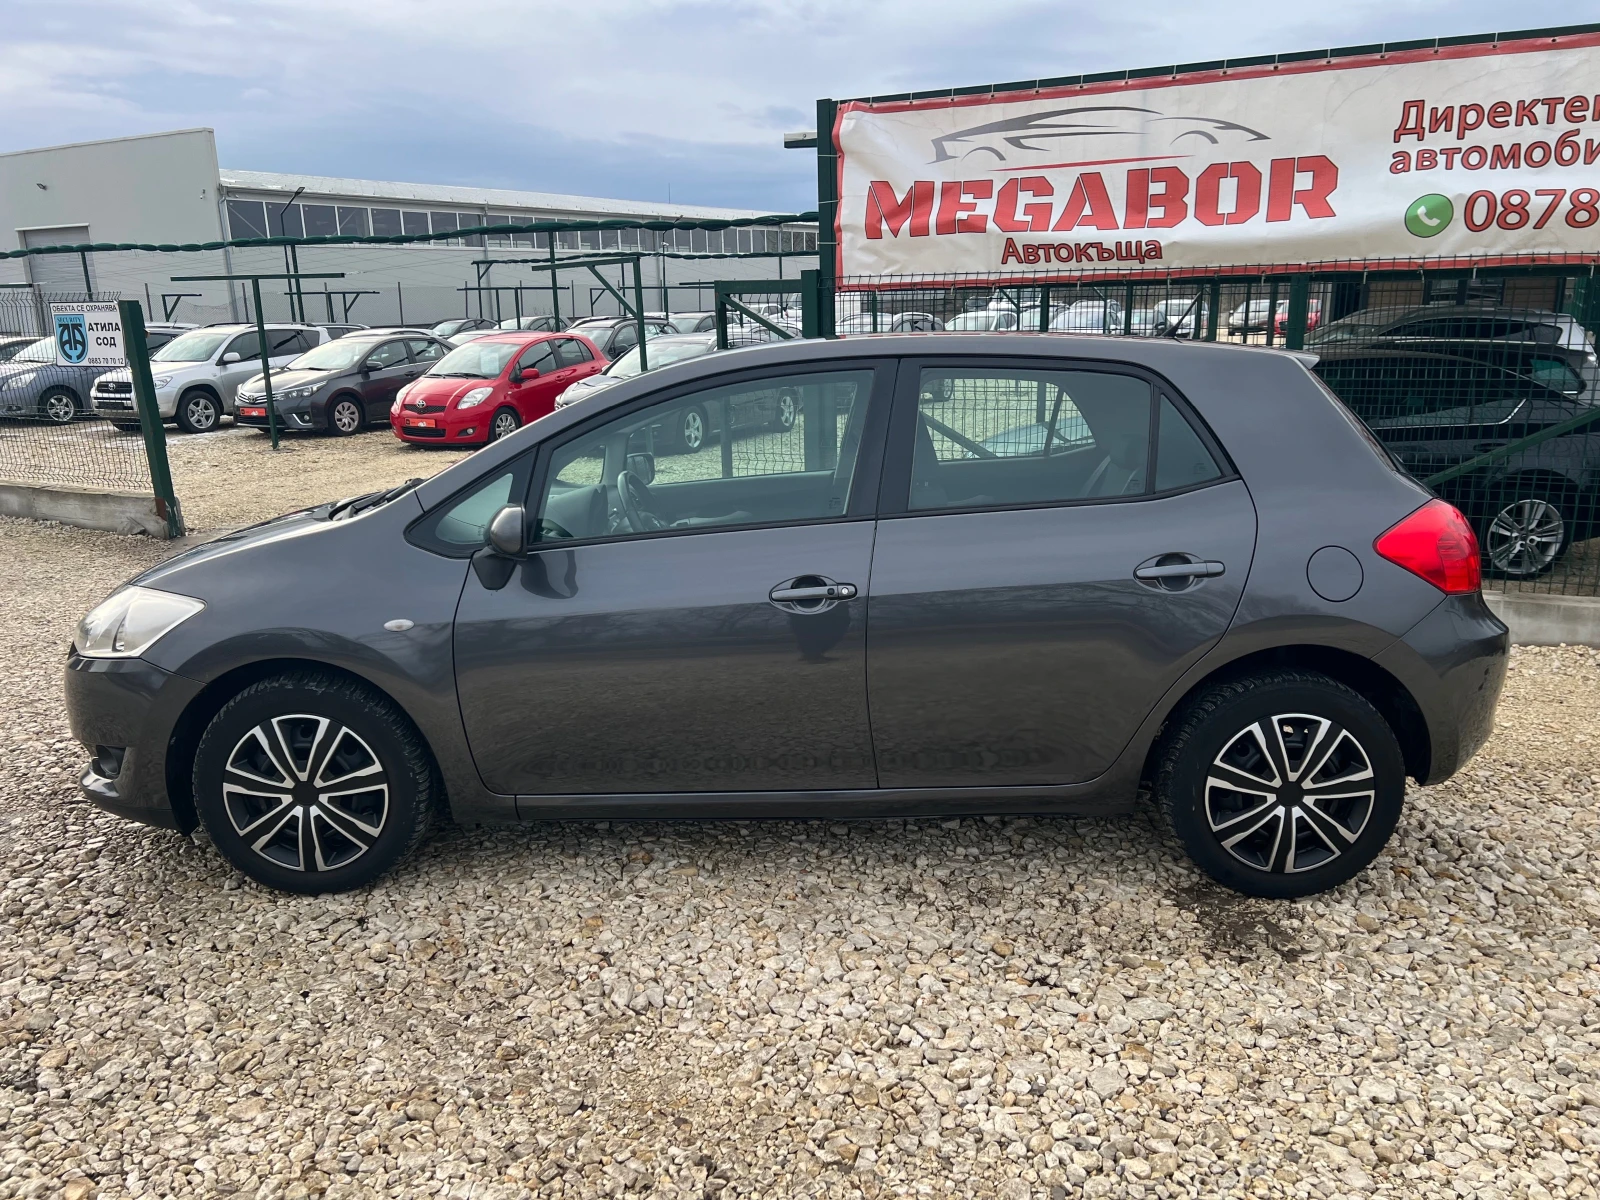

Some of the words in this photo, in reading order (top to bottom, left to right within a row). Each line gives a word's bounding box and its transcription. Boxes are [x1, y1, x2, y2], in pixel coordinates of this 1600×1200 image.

[864, 155, 1339, 240] MEGABOR
[1464, 188, 1600, 232] 0878
[1001, 237, 1163, 265] Автокъща
[88, 322, 120, 332] АТИЛА
[96, 337, 116, 347] СОД
